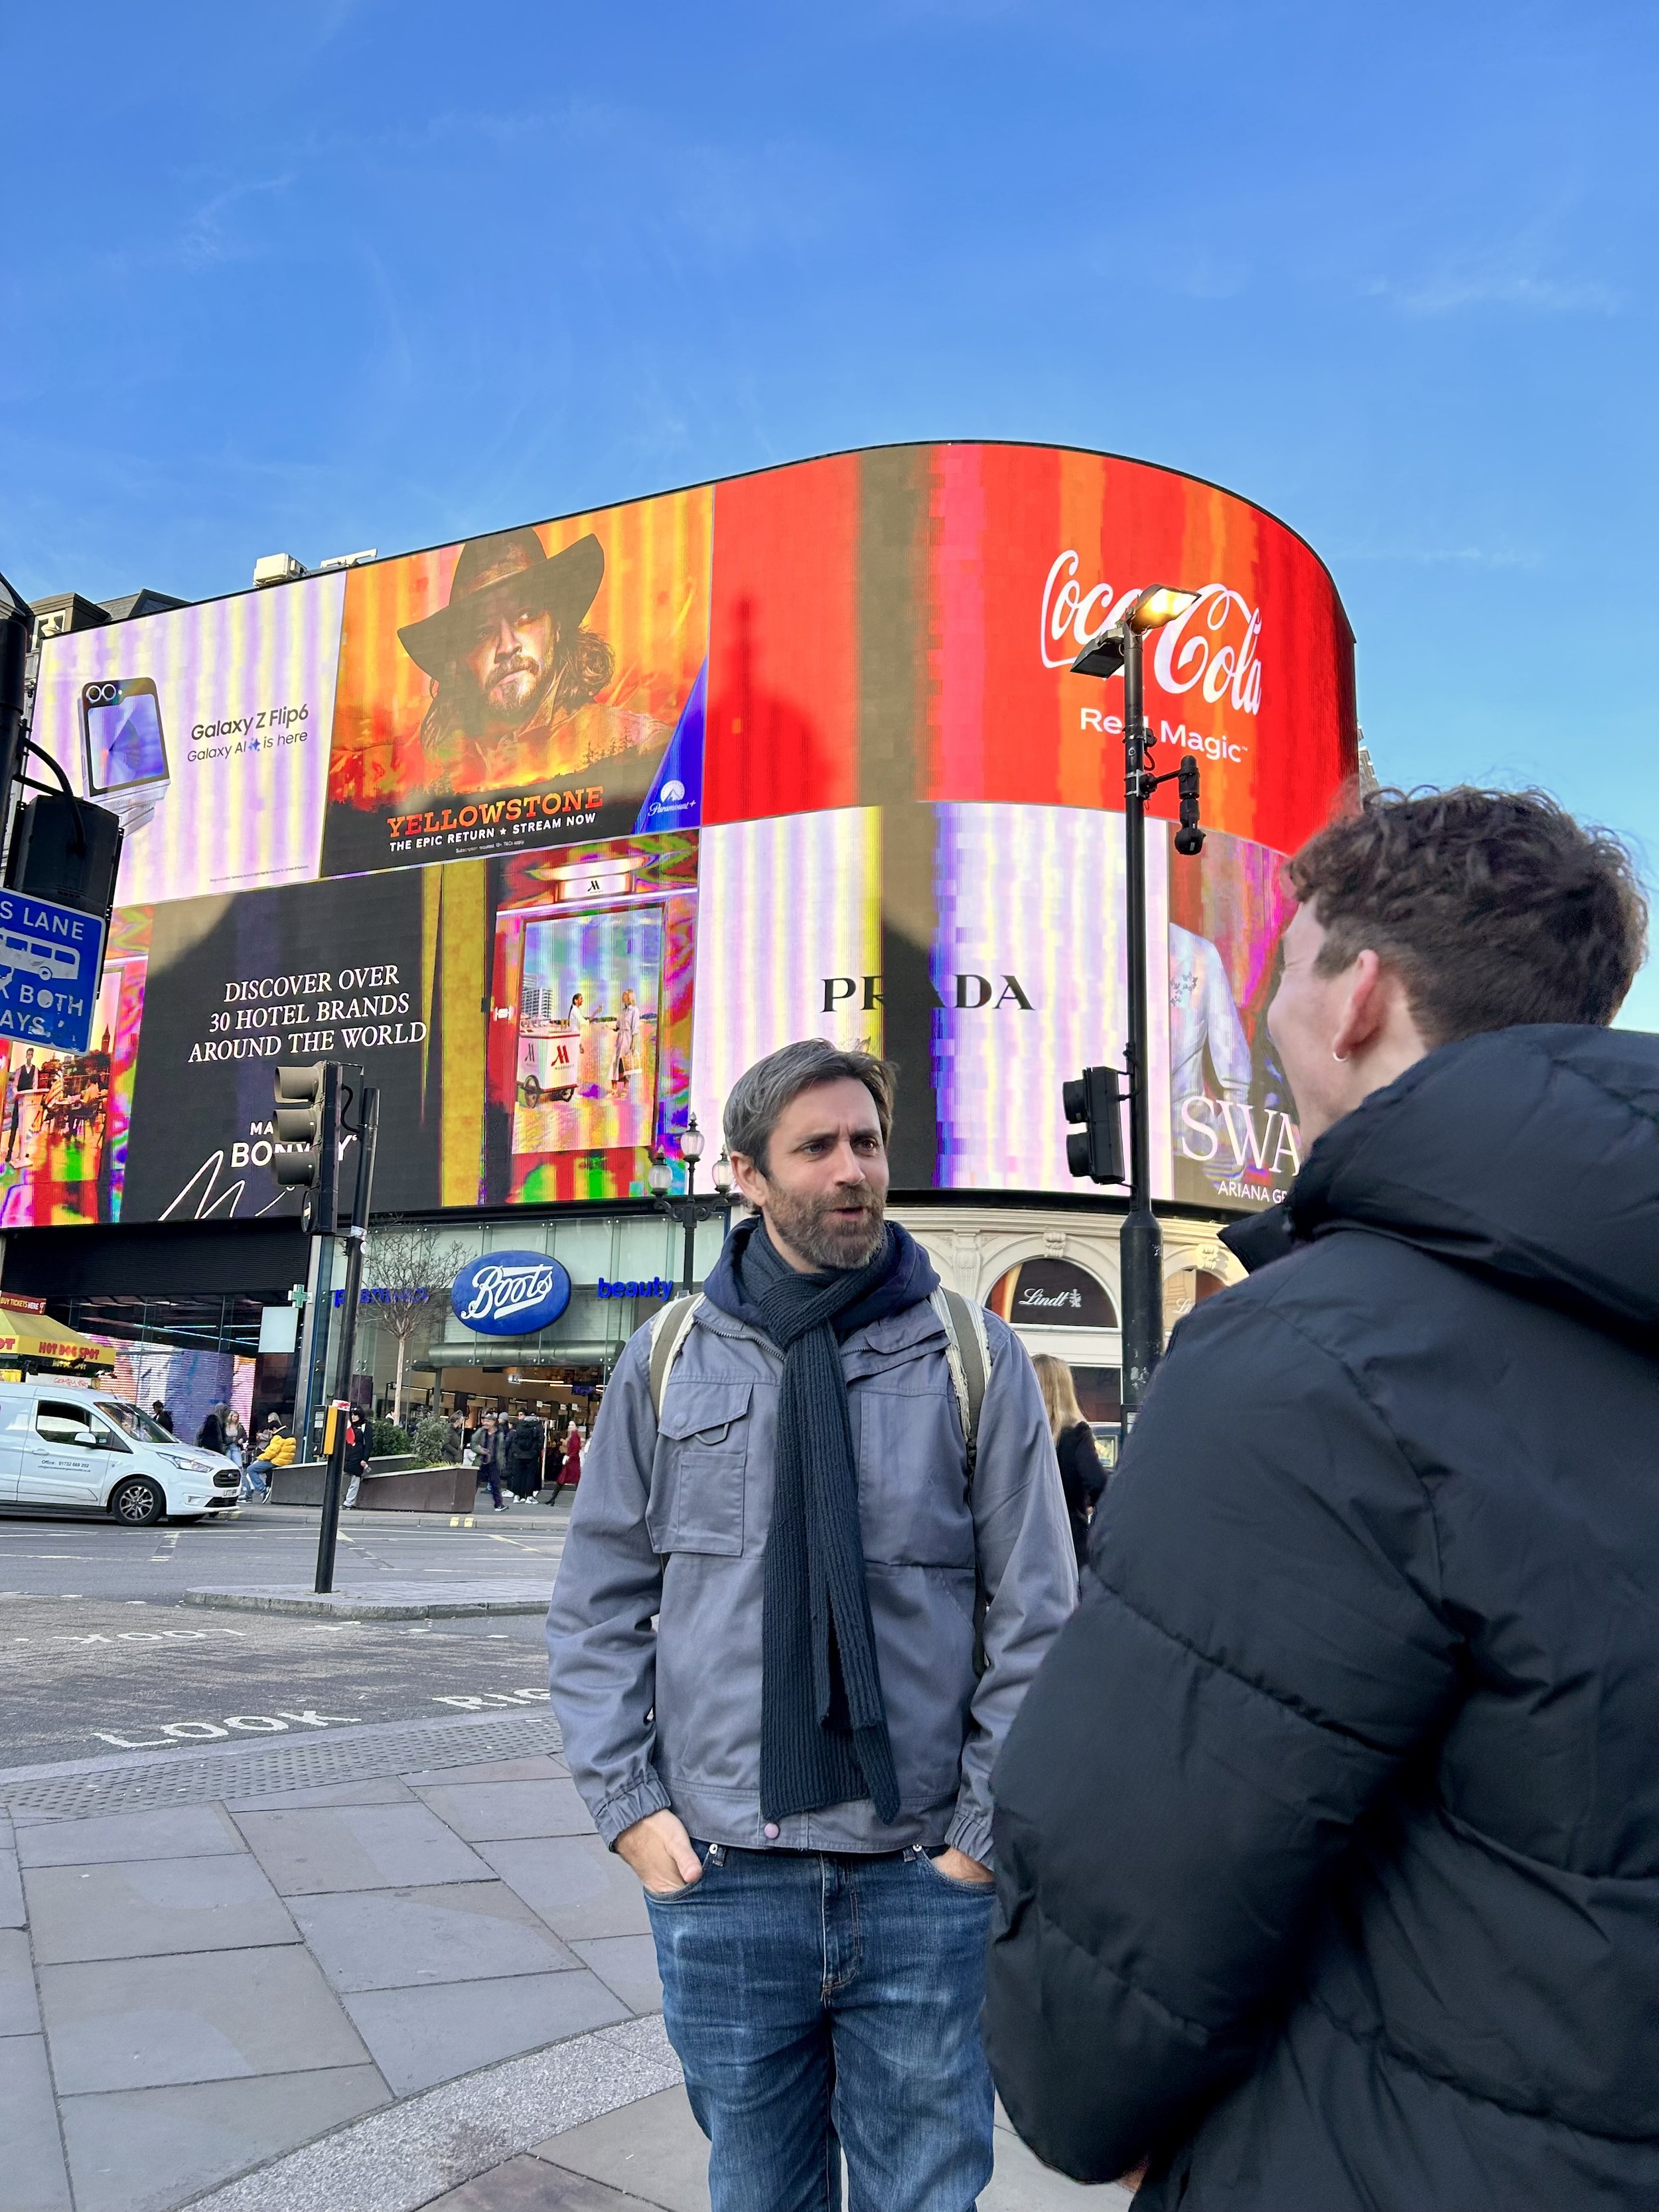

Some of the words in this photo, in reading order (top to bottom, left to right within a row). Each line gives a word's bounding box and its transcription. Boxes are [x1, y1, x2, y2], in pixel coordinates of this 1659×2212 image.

[191, 716, 254, 741] Galaxy
[255, 711, 266, 729] Z
[269, 703, 309, 729] Flip6
[1080, 707, 1149, 735] Rel
[187, 745, 232, 762] Galaxy
[234, 741, 247, 754] AI
[263, 736, 273, 749] is
[277, 731, 308, 747] here
[387, 785, 605, 838] YELLOWSTONE
[390, 840, 417, 853] THE
[417, 835, 443, 849] EPIC
[447, 828, 495, 844] RETURN
[512, 817, 562, 834] STREAM
[566, 812, 597, 827] NOW
[23, 907, 85, 941] LANE
[19, 984, 84, 1017] BOTH
[224, 977, 332, 1003] DISCOVER
[338, 964, 400, 990] OVER
[210, 1011, 230, 1033] 30
[235, 1005, 311, 1031] HOTEL
[316, 993, 411, 1022] BRANDS
[188, 1035, 282, 1063] AROUND
[287, 1029, 334, 1053] THE
[340, 1021, 428, 1049] WORLD
[1217, 1180, 1270, 1203] ARIANA
[10, 1298, 28, 1308] TICKETS
[460, 1264, 555, 1320] Boots
[598, 1276, 675, 1302] beauty
[1018, 1288, 1070, 1307] Lindt
[38, 1341, 58, 1355] HOT
[59, 1344, 77, 1357] DOG
[79, 1347, 100, 1361] SPOT
[90, 1710, 362, 1749] LOOK
